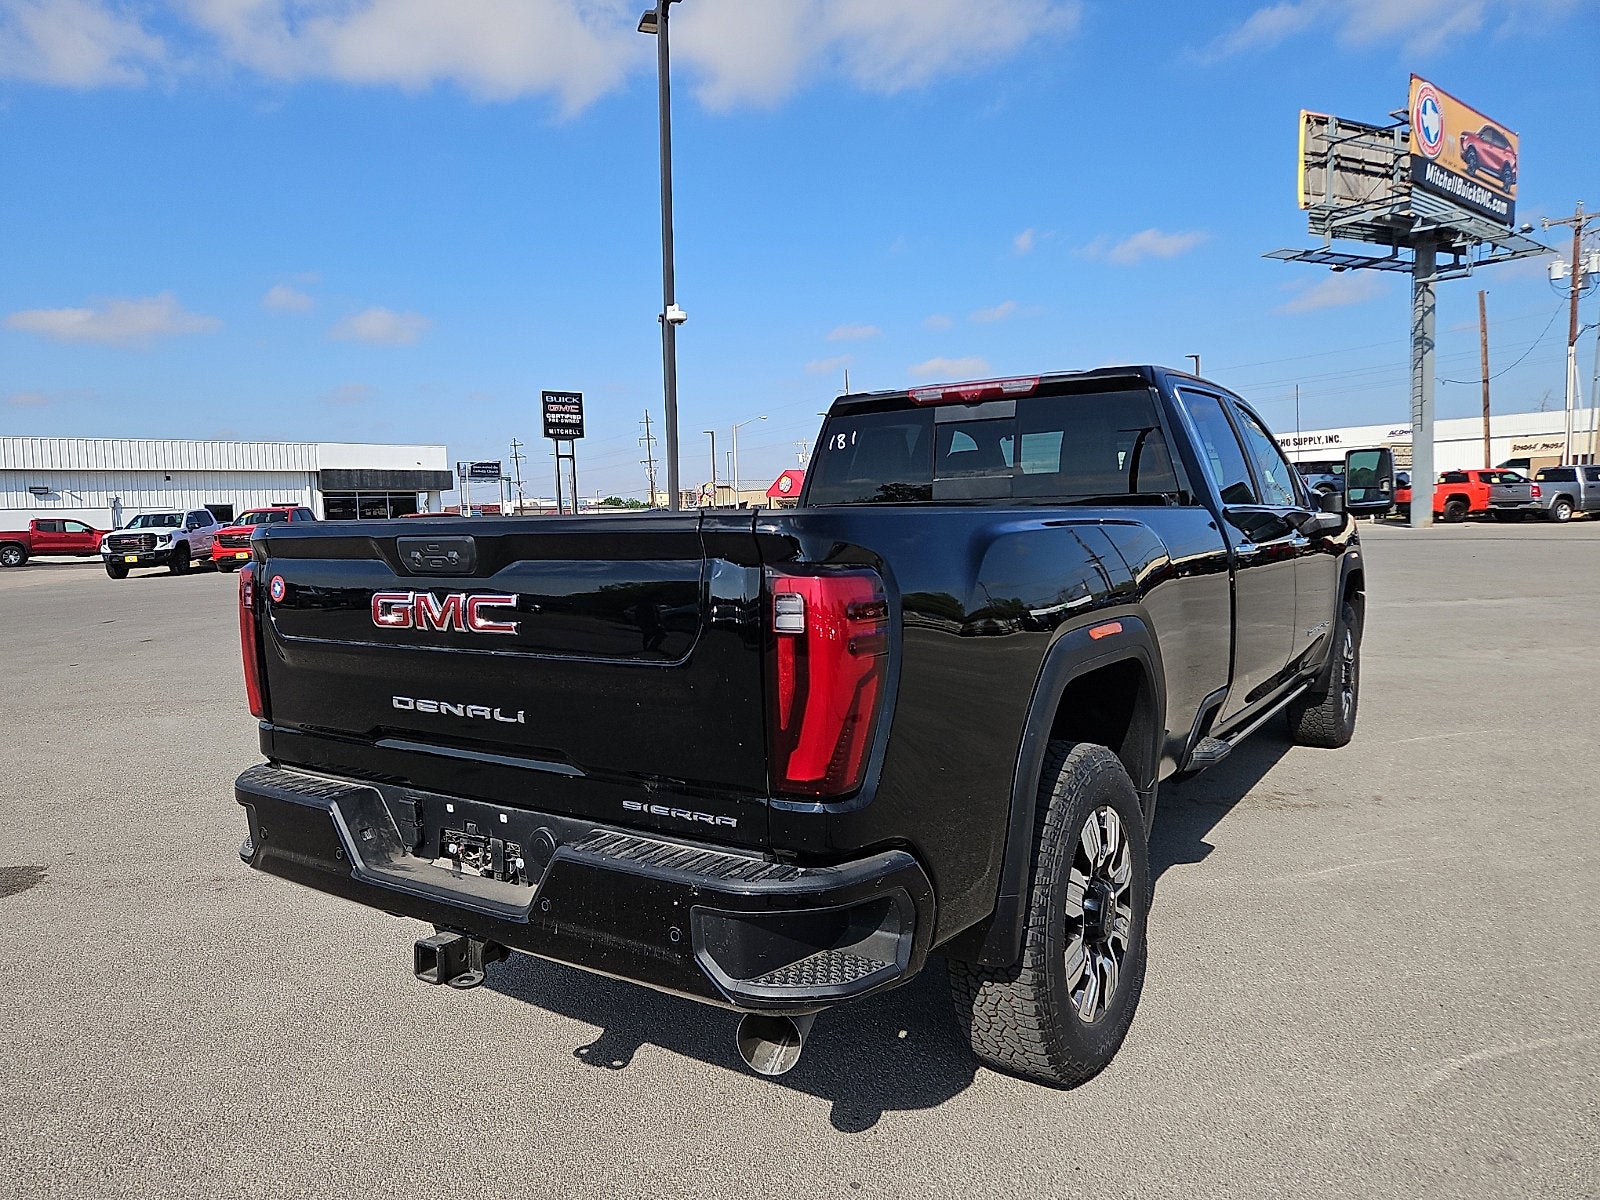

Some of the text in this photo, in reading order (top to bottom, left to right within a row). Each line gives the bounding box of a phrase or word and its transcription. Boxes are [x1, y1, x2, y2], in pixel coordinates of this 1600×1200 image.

[1425, 163, 1508, 215] MitchellBuickGMC.com
[545, 395, 580, 403] BUICK
[547, 404, 579, 412] GMC
[829, 430, 857, 451] 181
[1292, 435, 1324, 447] SUPPLY,
[1325, 434, 1343, 444] INC.
[371, 590, 520, 635] GMC
[392, 695, 525, 724] DENALI
[622, 800, 737, 828] SIERRA
